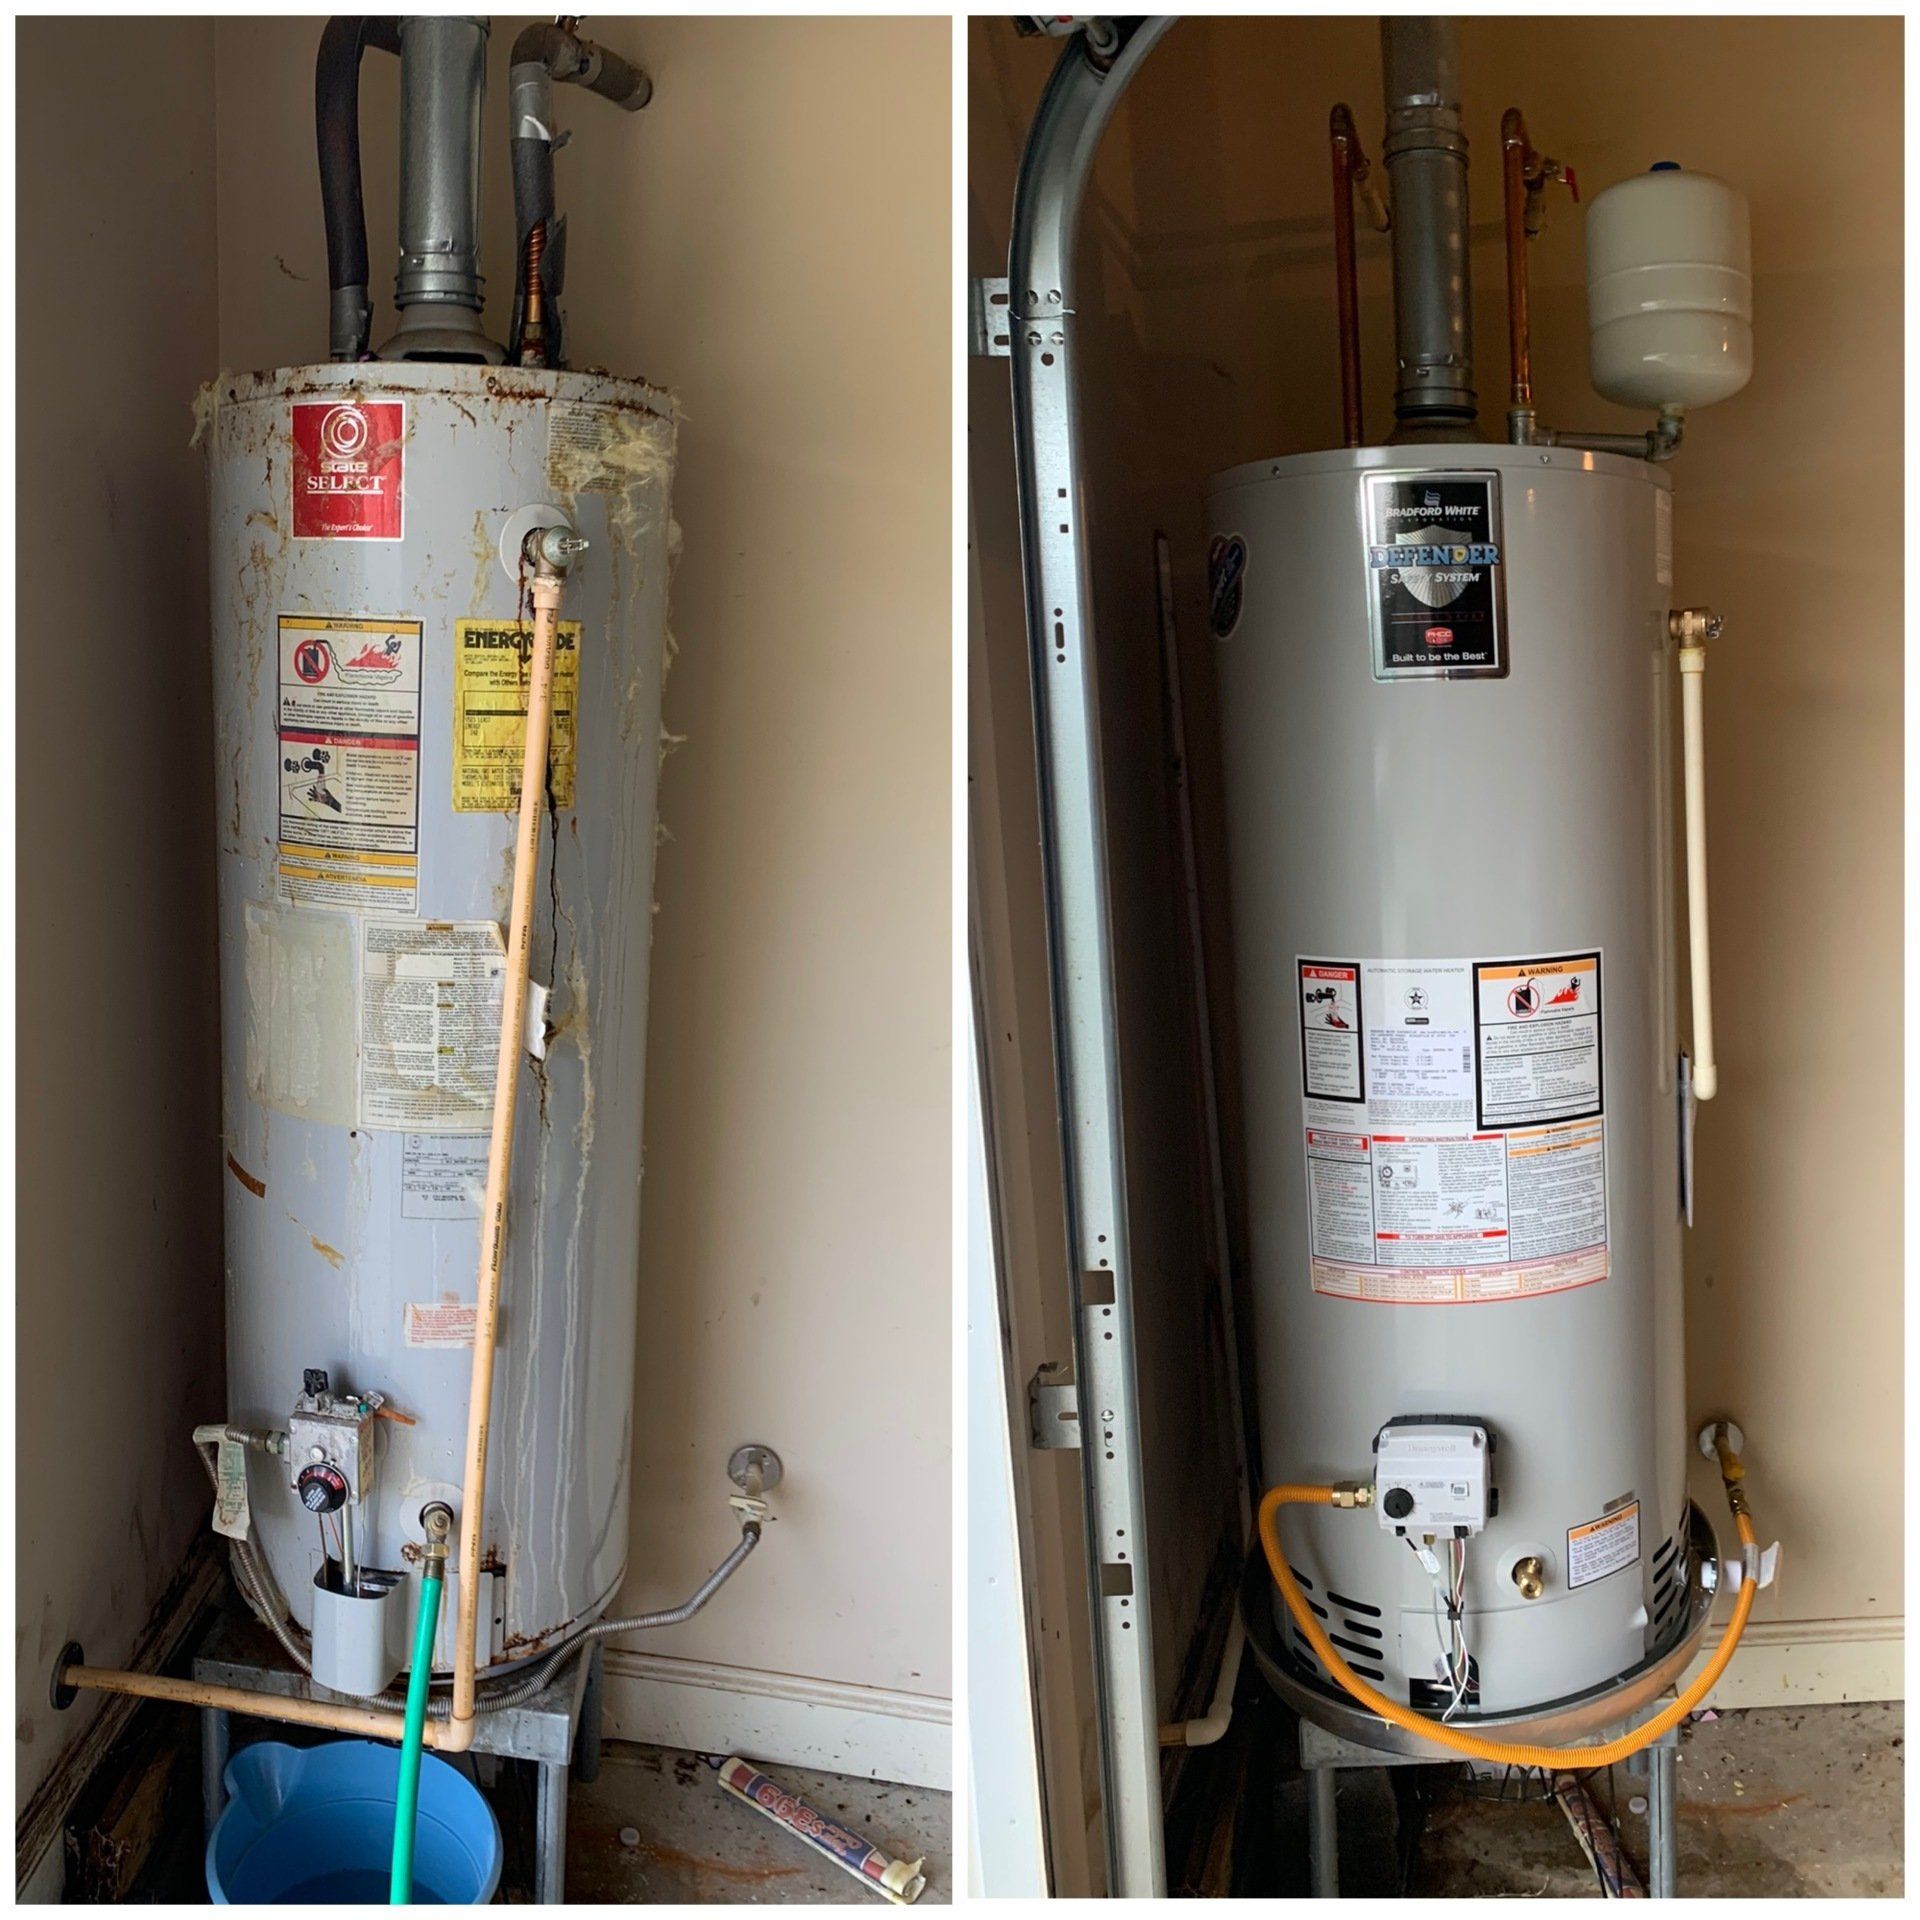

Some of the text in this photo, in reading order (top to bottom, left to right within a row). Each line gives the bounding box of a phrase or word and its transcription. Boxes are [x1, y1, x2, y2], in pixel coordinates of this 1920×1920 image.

[321, 461, 368, 473] state
[307, 475, 386, 490] SELECT
[1386, 505, 1482, 517] BRADFORD WHITE
[1370, 543, 1499, 568] DEFENDER
[1434, 572, 1481, 583] SYSTEM
[334, 622, 363, 630] WARNING
[464, 631, 575, 650] ENERGYDE
[1392, 652, 1485, 662] Built to be the Best
[464, 669, 488, 679] Compare
[490, 670, 498, 678] the
[499, 670, 518, 680] Energy
[332, 853, 360, 861] WARNING
[1318, 970, 1349, 979] DANGER
[1527, 966, 1563, 976] WARNING
[494, 1202, 502, 1223] GOLD
